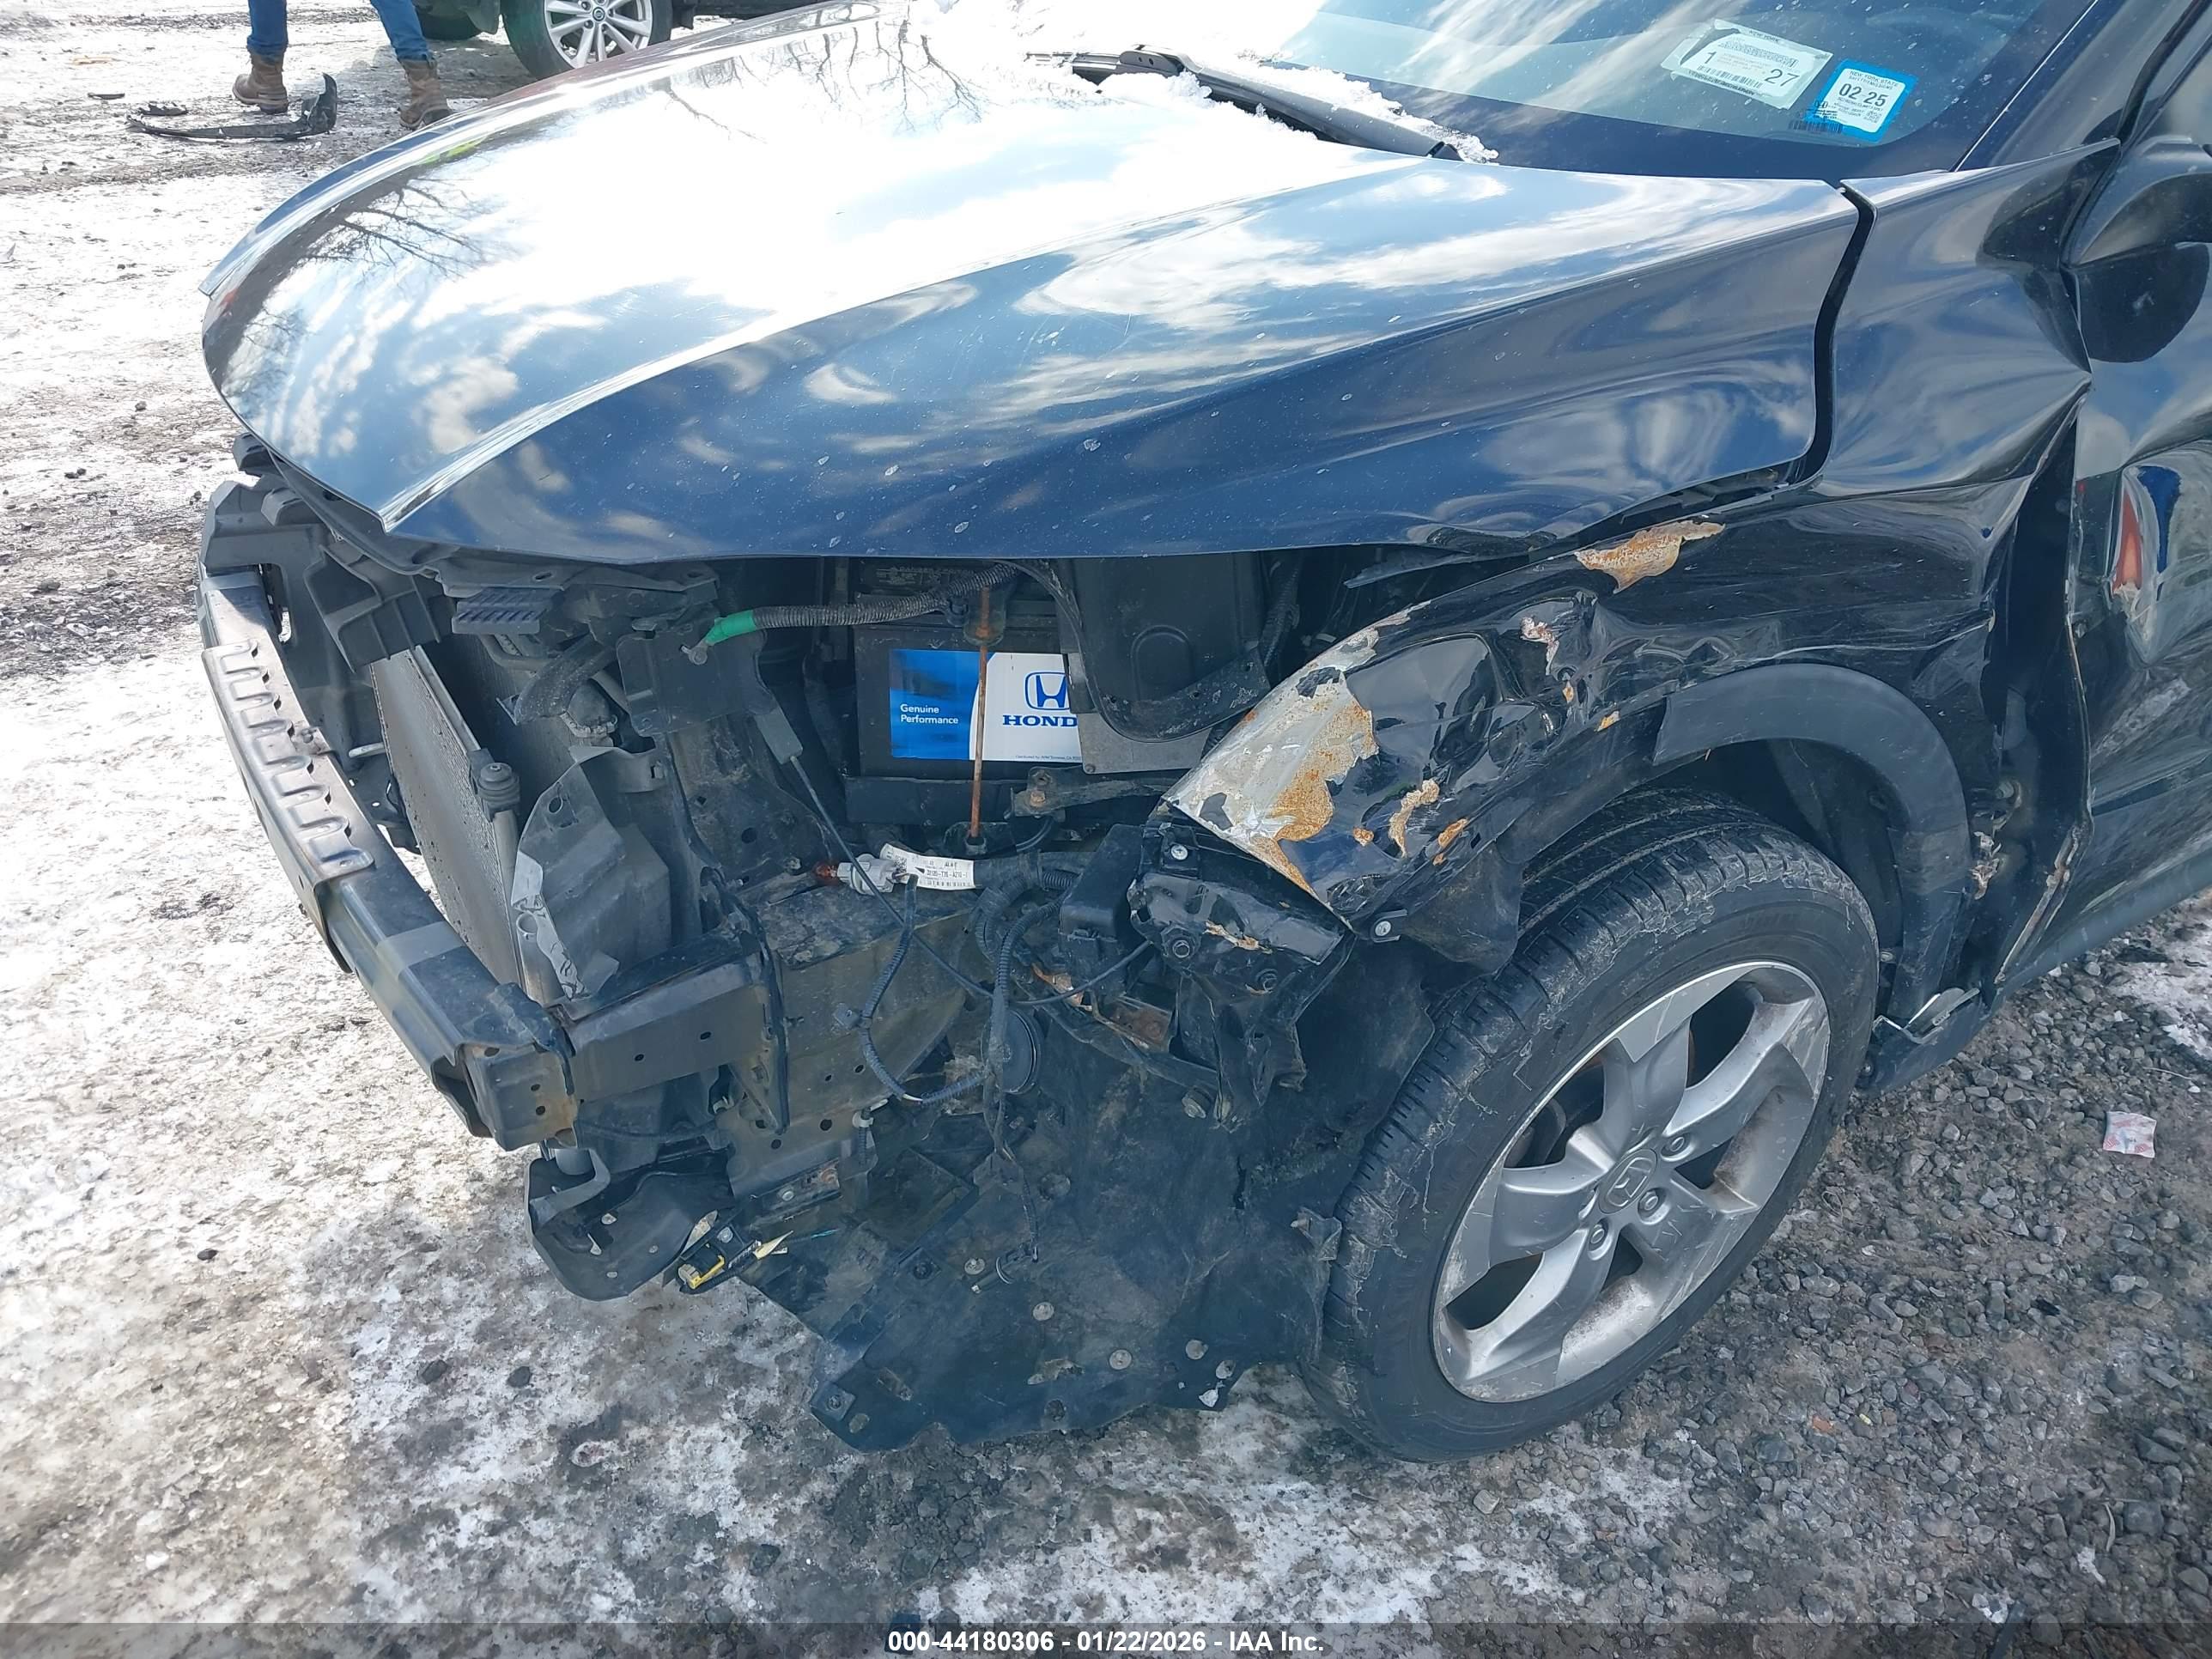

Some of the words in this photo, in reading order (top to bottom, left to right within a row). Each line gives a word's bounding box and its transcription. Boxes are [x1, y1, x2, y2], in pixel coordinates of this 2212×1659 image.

[1705, 52, 1716, 64] 1
[1764, 69, 1800, 88] 27
[1838, 83, 1862, 100] 02
[1863, 92, 1889, 106] 25
[900, 703, 939, 714] Genuine
[900, 714, 959, 725] Performance
[1002, 714, 1078, 727] HOND
